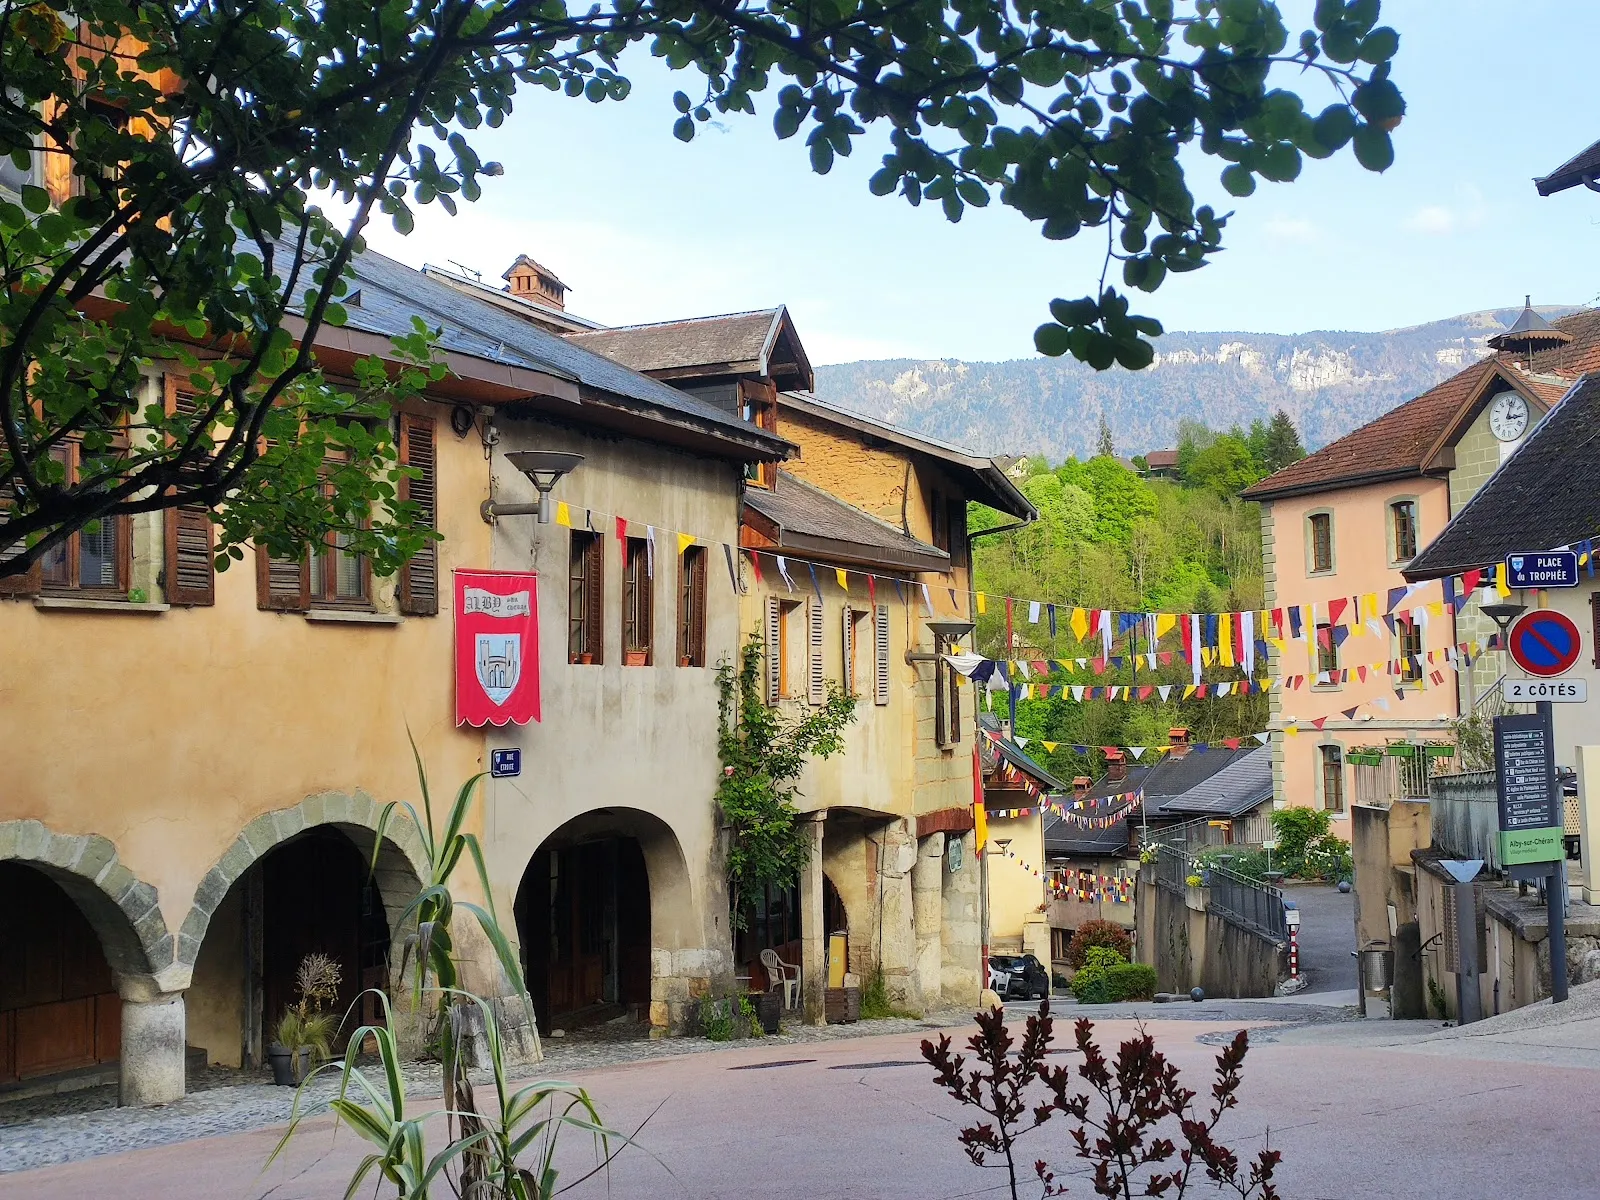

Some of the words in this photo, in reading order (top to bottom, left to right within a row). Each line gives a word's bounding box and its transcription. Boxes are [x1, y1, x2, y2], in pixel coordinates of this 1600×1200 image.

[1537, 557, 1562, 568] PLACE
[1516, 572, 1526, 581] du
[1529, 569, 1567, 581] TROPHÉE
[1513, 685, 1522, 696] 2
[1528, 683, 1576, 696] CÔTÉS
[1509, 837, 1554, 848] Alby-sur-Chéran
